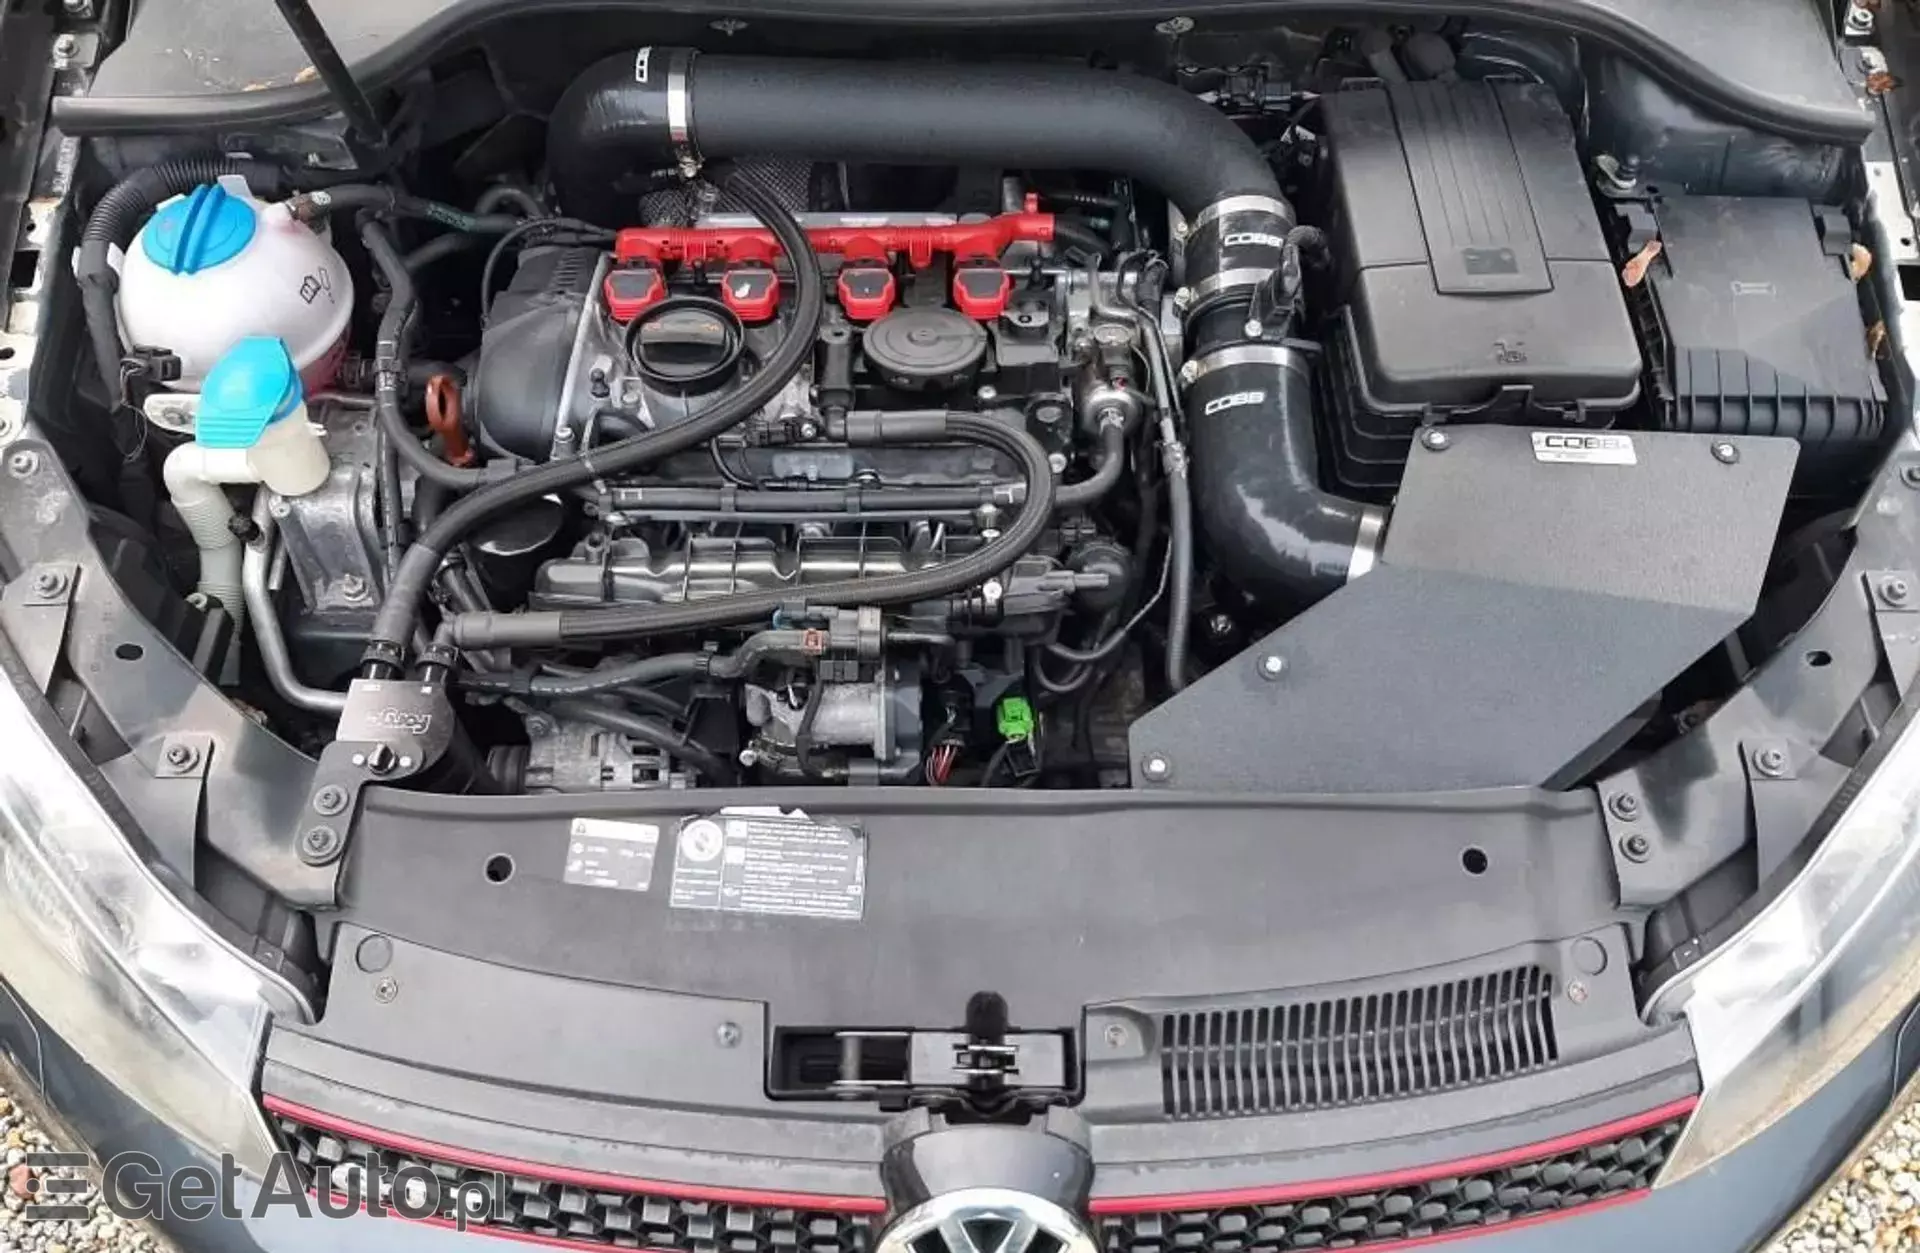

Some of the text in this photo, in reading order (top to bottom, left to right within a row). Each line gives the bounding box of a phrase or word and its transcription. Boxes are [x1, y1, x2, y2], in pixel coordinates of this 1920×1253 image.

[1224, 232, 1284, 248] COBB
[1204, 390, 1266, 416] COBB
[1545, 435, 1620, 450] COBB
